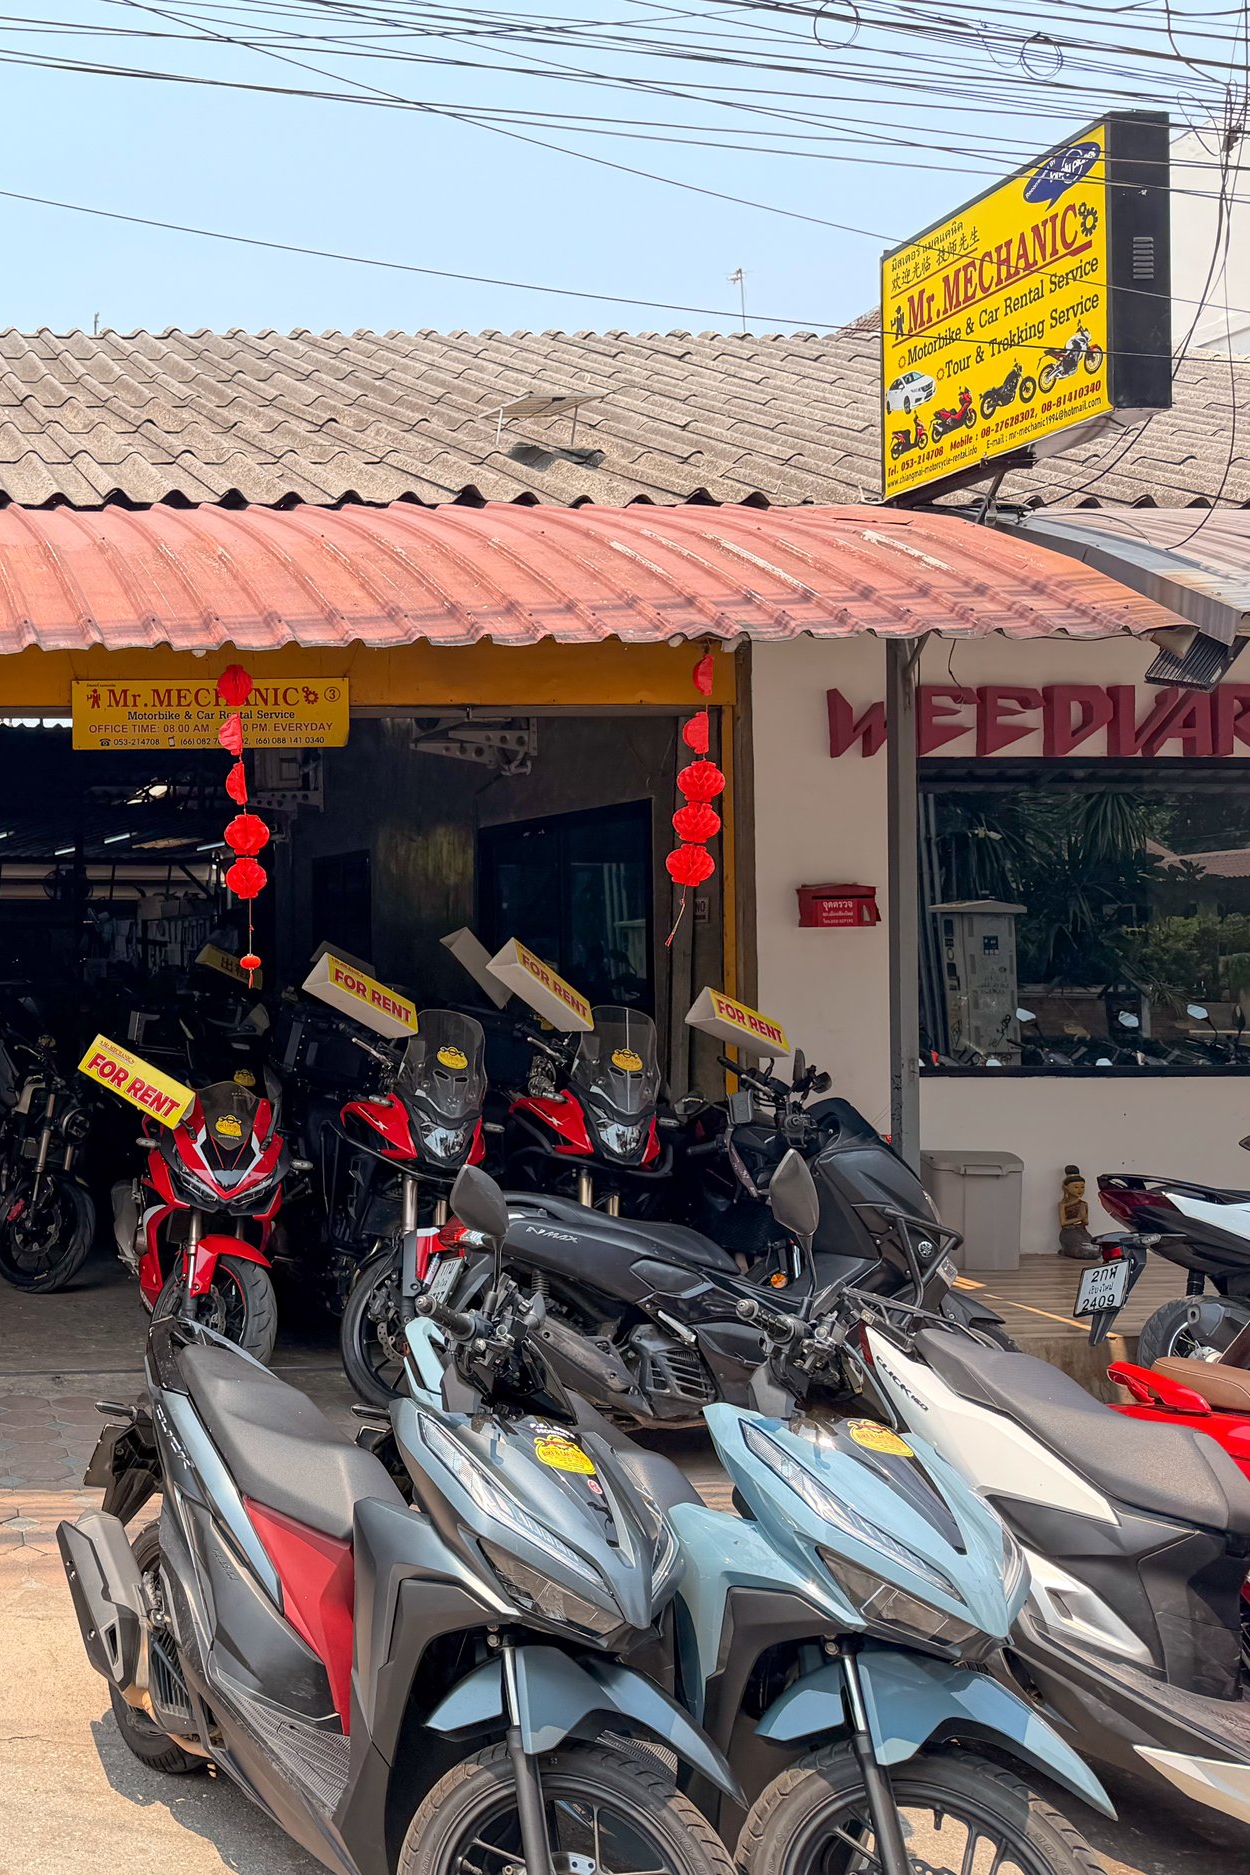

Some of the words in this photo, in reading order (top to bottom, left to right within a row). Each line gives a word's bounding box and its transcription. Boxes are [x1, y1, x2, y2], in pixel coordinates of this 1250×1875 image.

[908, 203, 1078, 334] Mr.MECHANIC
[908, 328, 962, 367] Motorbike
[966, 317, 974, 334] &
[979, 306, 1000, 329] Car
[1004, 279, 1044, 317] Rental
[1050, 257, 1098, 295] Service
[945, 353, 970, 379] Tour
[975, 346, 984, 364] &
[989, 319, 1045, 358] Trekking
[1050, 294, 1099, 330] Service
[888, 465, 898, 478] Tel.
[900, 446, 944, 472] 053-214708
[981, 407, 1038, 438] 08-27628302,
[1042, 380, 1102, 414] 08-81410340
[107, 687, 300, 708] Mr.MECHNIC
[128, 711, 180, 720] Motorbike
[184, 711, 192, 720] &
[196, 710, 215, 720] Car
[219, 710, 252, 720] Retal
[257, 710, 295, 719] Service
[89, 724, 128, 734] OFFICE
[132, 724, 160, 734] TIME:
[163, 724, 190, 733] 08.00
[252, 723, 270, 732] PM.
[273, 722, 333, 732] EVERYDAY
[114, 738, 160, 746] 053-214708
[180, 738, 195, 746] (66)
[290, 736, 302, 744] 141
[335, 968, 367, 999] FOR
[372, 988, 412, 1022] RENT
[522, 952, 550, 986] FOR
[553, 980, 588, 1017] RENT
[716, 998, 746, 1026] FOR
[748, 1014, 782, 1044] RENT
[86, 1052, 130, 1088] FOR
[126, 1077, 180, 1118] RENT
[1082, 1294, 1115, 1310] 2409
